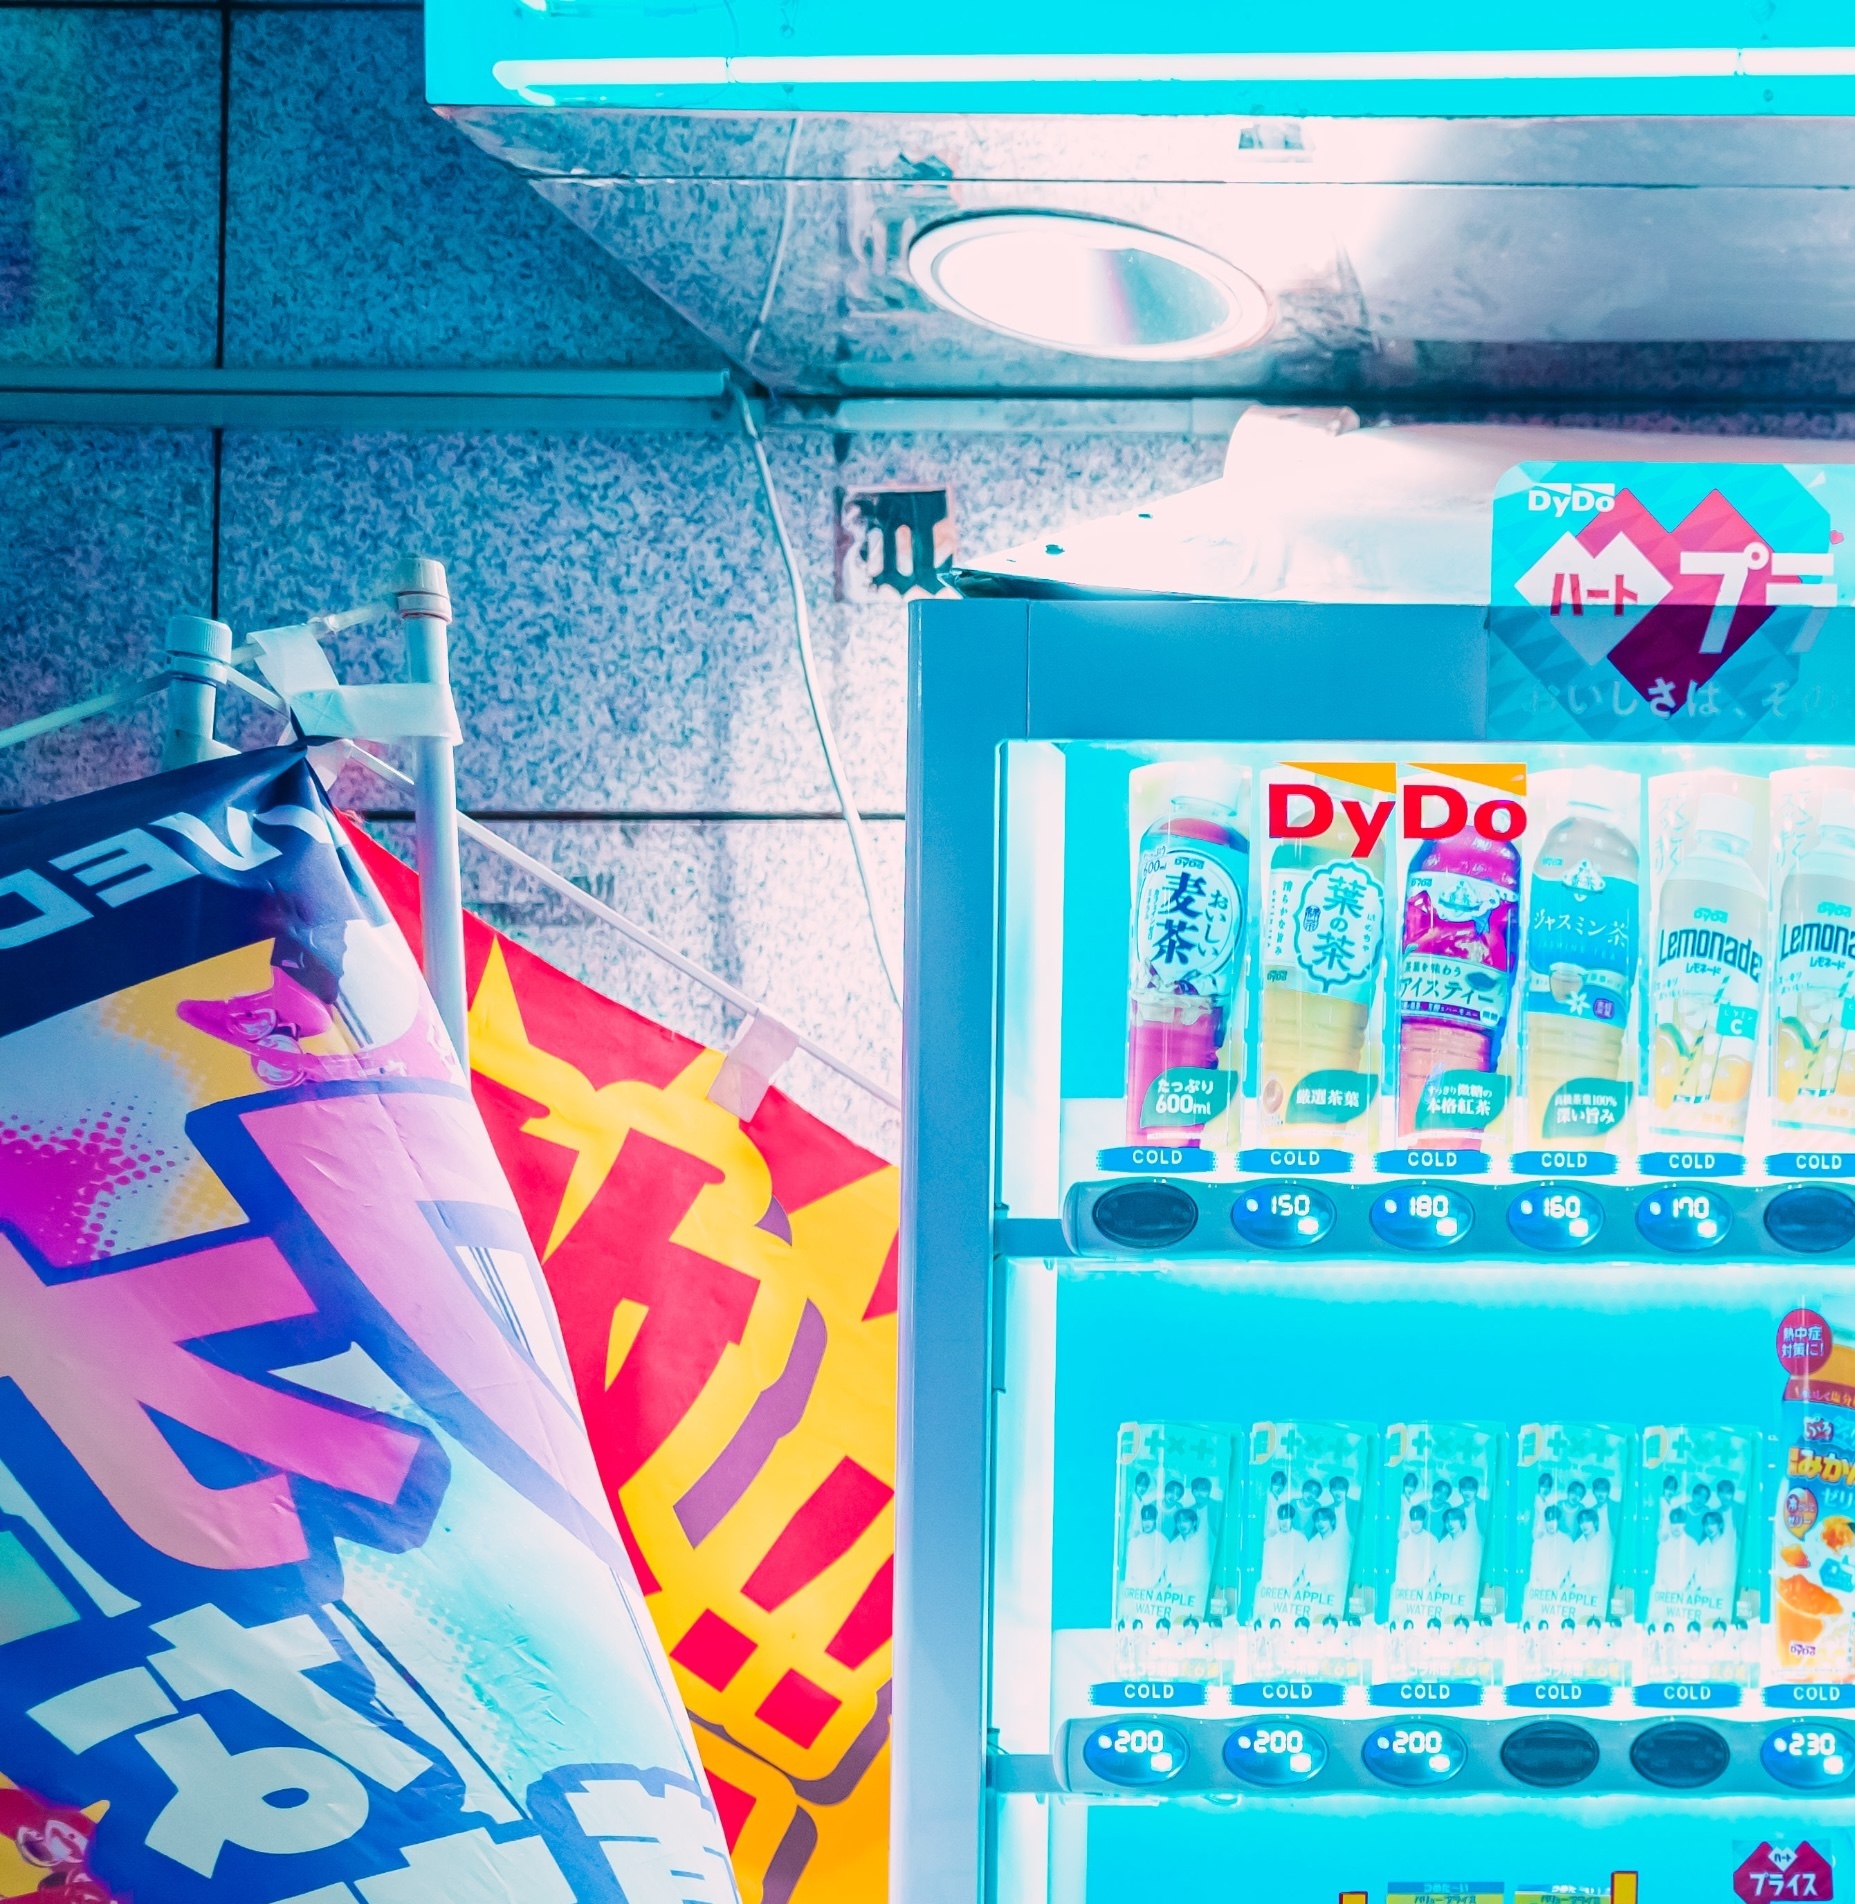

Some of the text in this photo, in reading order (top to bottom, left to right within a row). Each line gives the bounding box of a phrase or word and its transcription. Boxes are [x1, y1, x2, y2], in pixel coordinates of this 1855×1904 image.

[1527, 482, 1616, 517] DyDo
[1550, 571, 1640, 619] ハート
[1268, 783, 1528, 858] DyDo
[1153, 871, 1211, 965] 麦茶
[1317, 875, 1366, 971] 葉の茶
[1532, 907, 1629, 948] ジャスミン茶
[1658, 927, 1764, 984] Lemonade
[1157, 1079, 1215, 1096] たっぷり
[1155, 1093, 1212, 1116] 600ml
[1407, 1151, 1458, 1168] COLD
[1541, 1152, 1589, 1169] COLD
[1668, 1153, 1716, 1171] COLD
[1796, 1153, 1843, 1171] COLD
[1269, 1195, 1311, 1217] 150
[1409, 1196, 1450, 1218] 180
[1542, 1197, 1583, 1219] 160
[1672, 1198, 1710, 1219] 170
[1114, 1729, 1164, 1755] 200
[1253, 1729, 1303, 1755] 200
[1392, 1729, 1442, 1755] 200
[1788, 1733, 1836, 1756] 230
[1749, 1871, 1819, 1897] プライス
